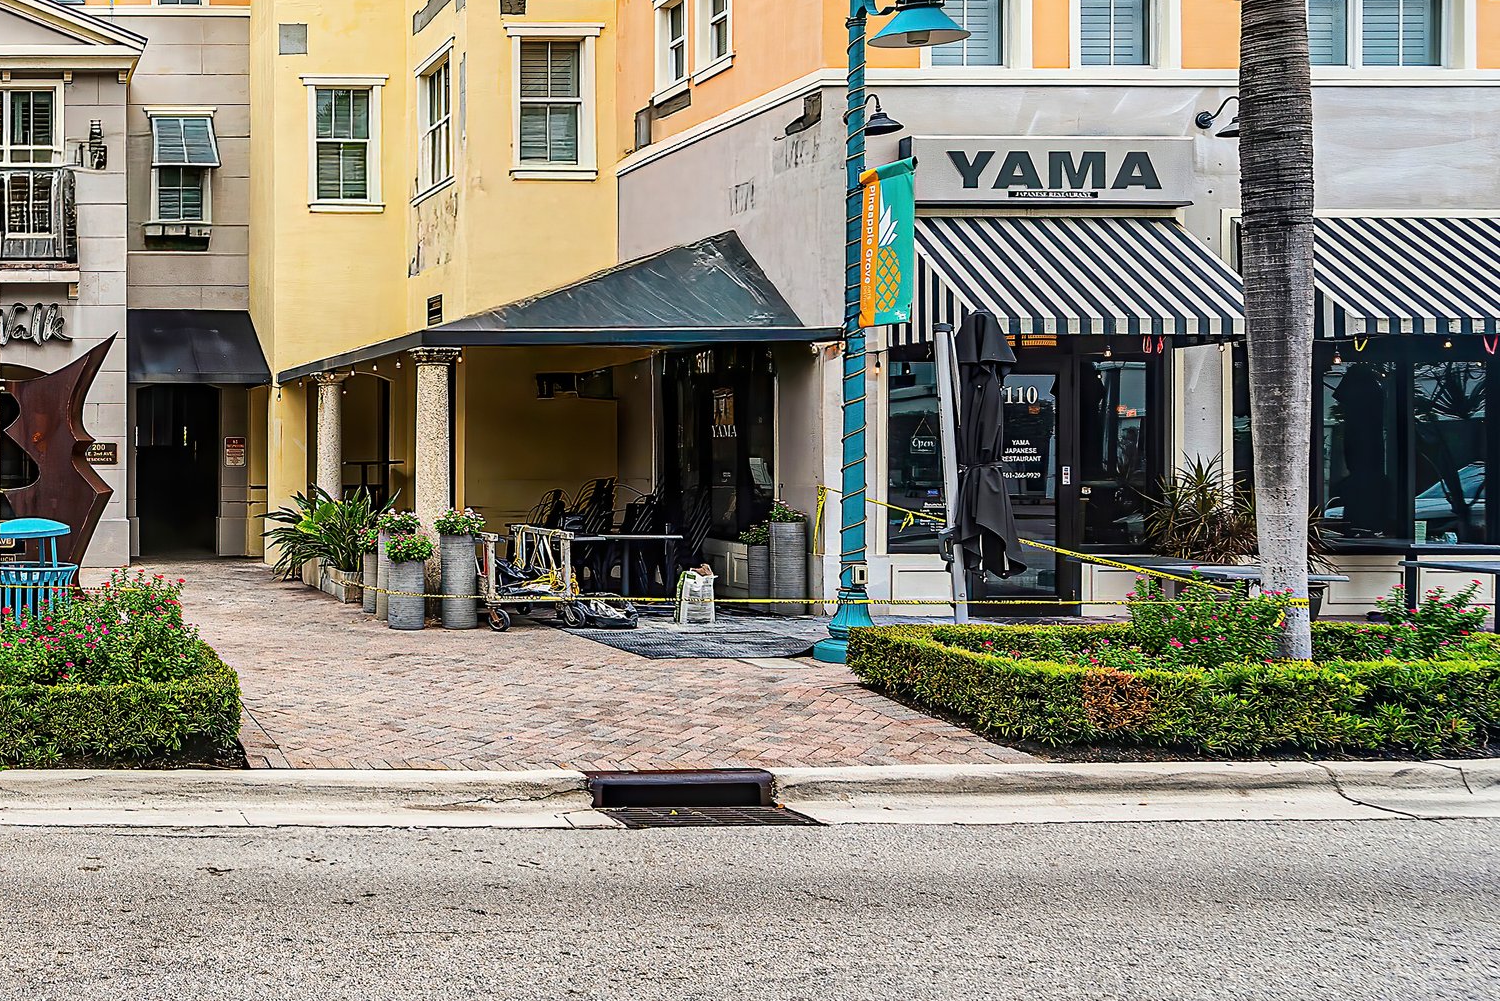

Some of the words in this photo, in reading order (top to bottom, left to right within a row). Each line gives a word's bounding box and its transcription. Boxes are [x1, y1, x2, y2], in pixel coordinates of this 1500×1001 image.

[946, 150, 1163, 189] YAMA
[866, 185, 875, 245] Pineapple
[864, 248, 873, 284] Grove
[1004, 386, 1038, 404] 110
[712, 425, 737, 437] YAMA
[911, 438, 935, 449] Open
